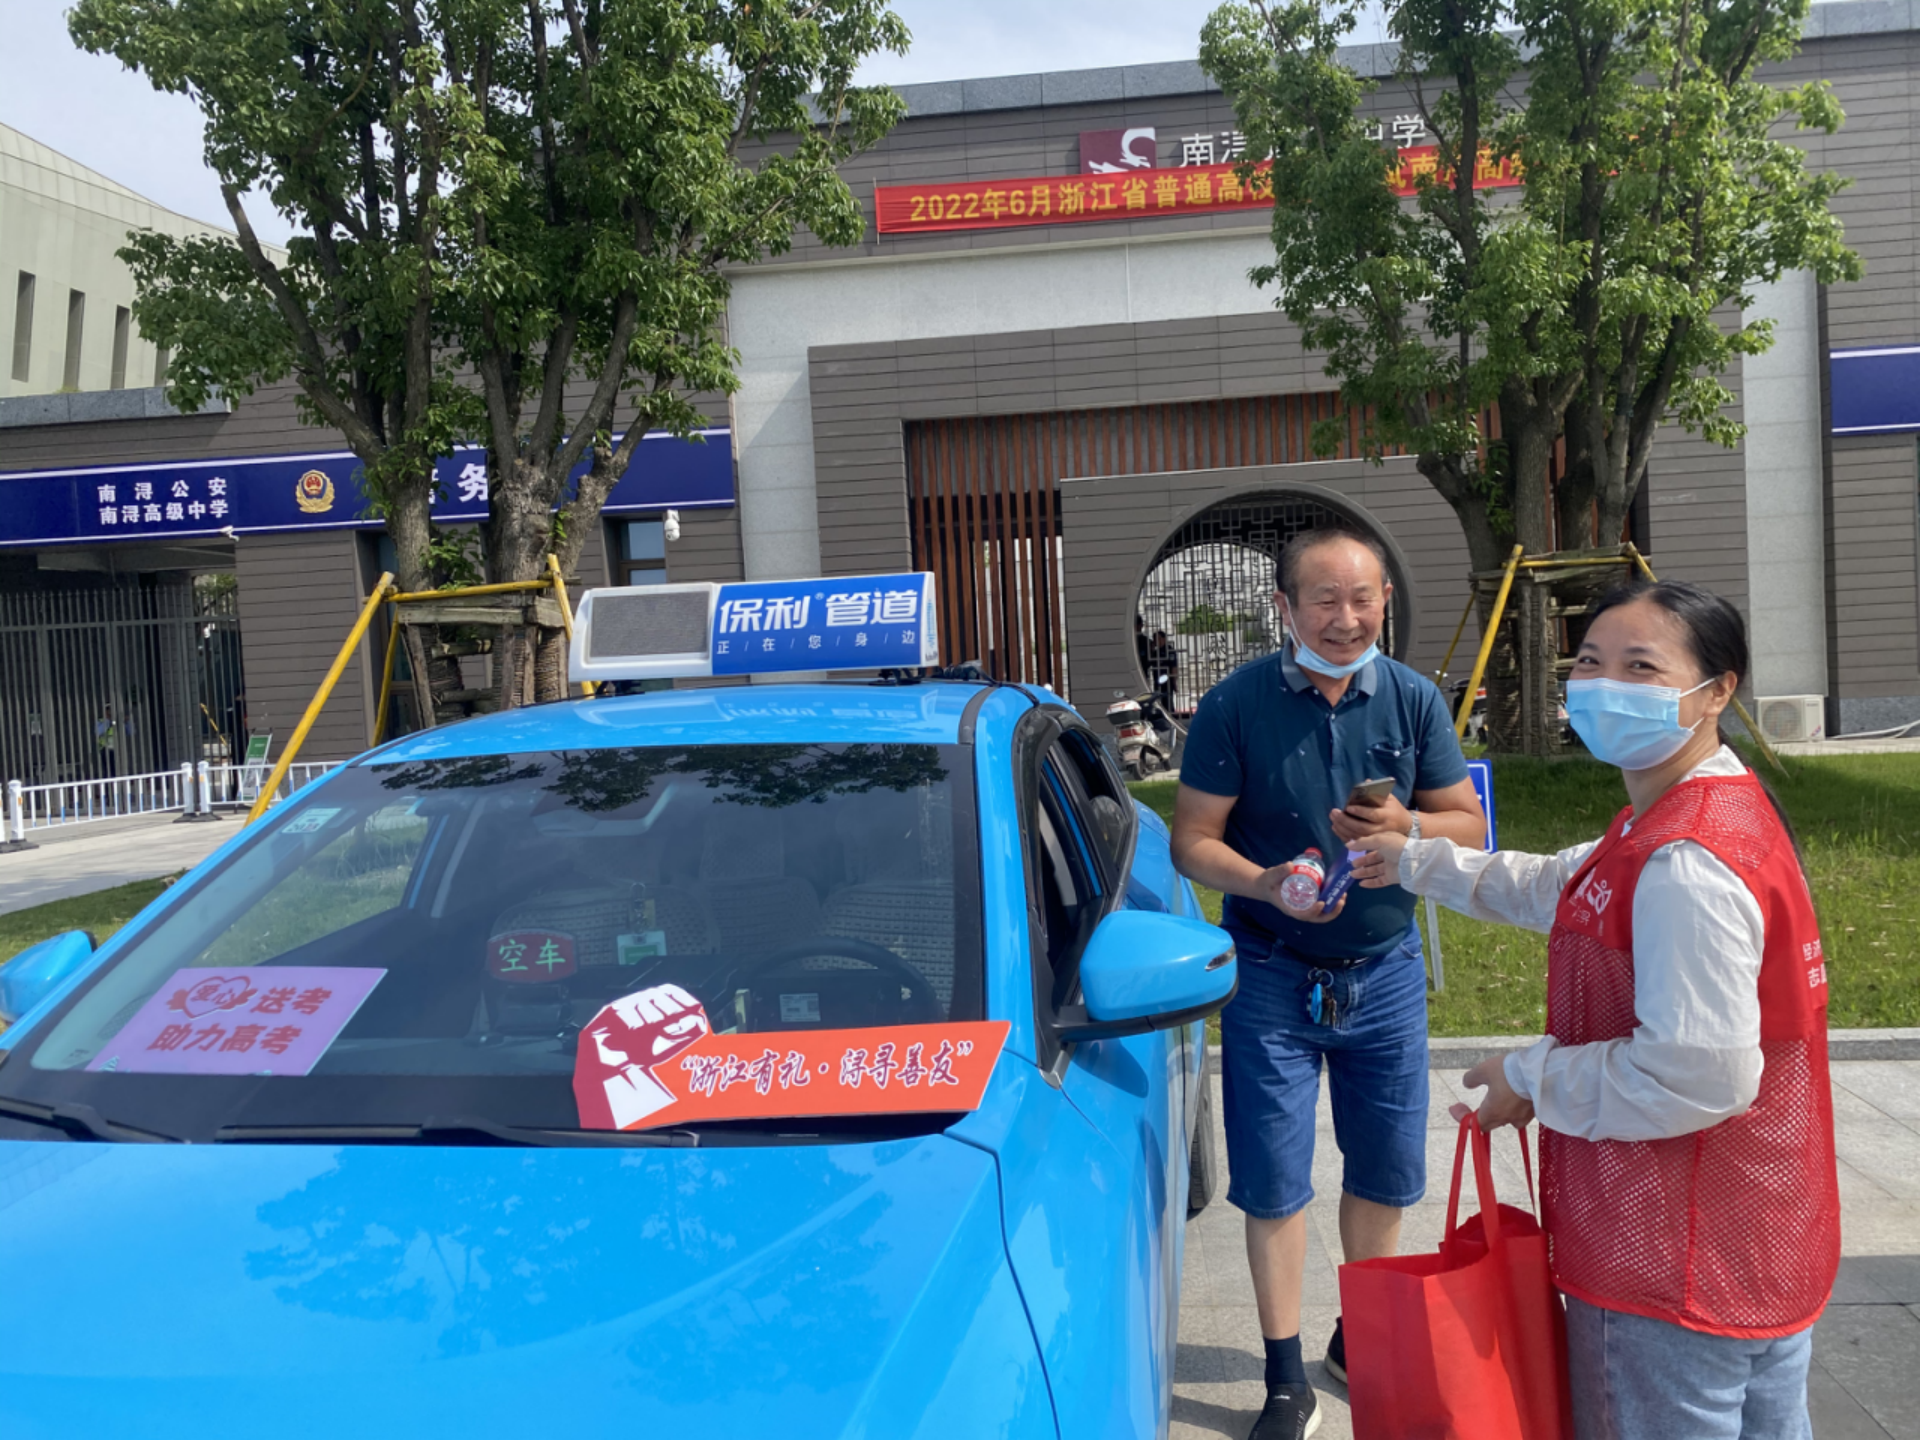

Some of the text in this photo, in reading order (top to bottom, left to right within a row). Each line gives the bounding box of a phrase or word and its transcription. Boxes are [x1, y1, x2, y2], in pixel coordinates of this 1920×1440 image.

[97, 476, 228, 503] 南浔公安
[98, 499, 229, 525] 南浔高级中学
[499, 938, 566, 974] 空车
[250, 986, 333, 1015] 送考
[146, 1022, 303, 1055] 助力高考
